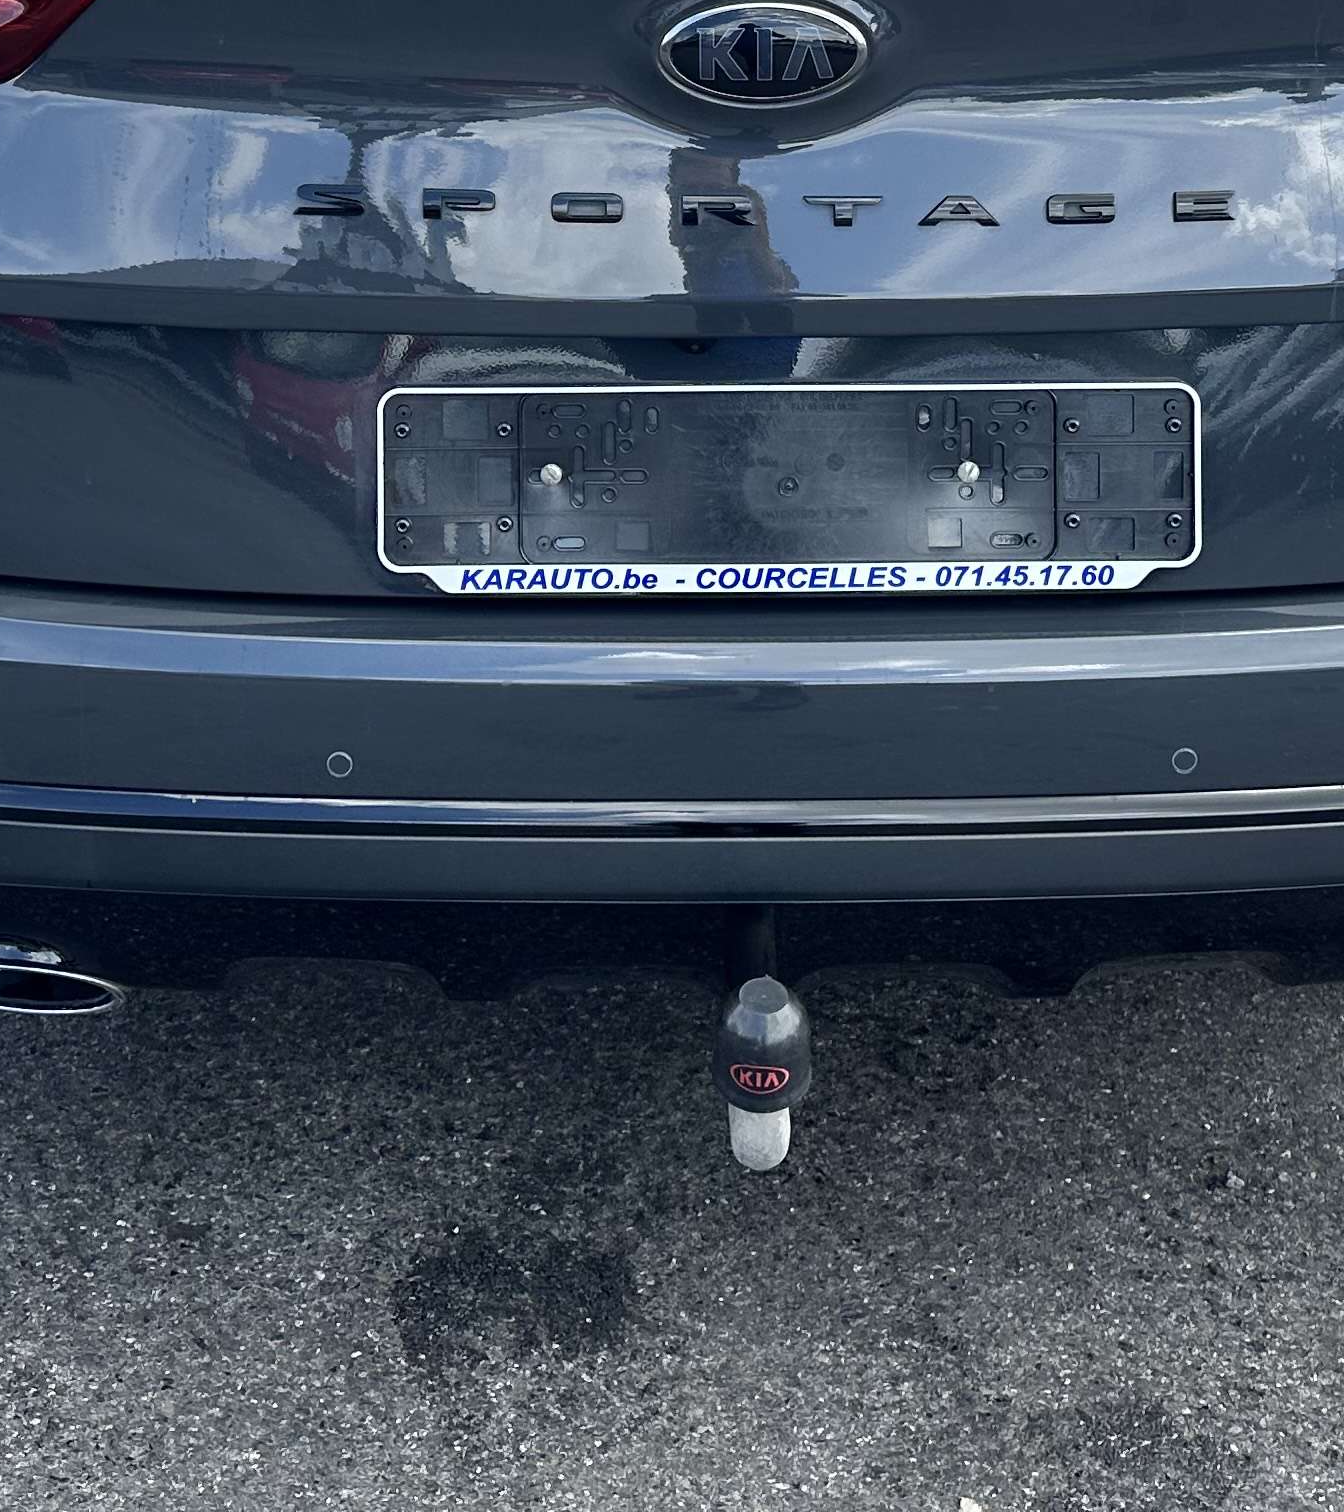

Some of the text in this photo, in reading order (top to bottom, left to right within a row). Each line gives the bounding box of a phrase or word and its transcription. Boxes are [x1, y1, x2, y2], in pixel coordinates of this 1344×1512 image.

[696, 27, 834, 81] KIA
[293, 183, 1236, 228] SPORTAGE
[460, 568, 658, 590] KARAUTO.be
[696, 567, 907, 590] COURCELLES
[935, 565, 1115, 587] 071.45.17.60
[739, 1068, 780, 1088] KIA
